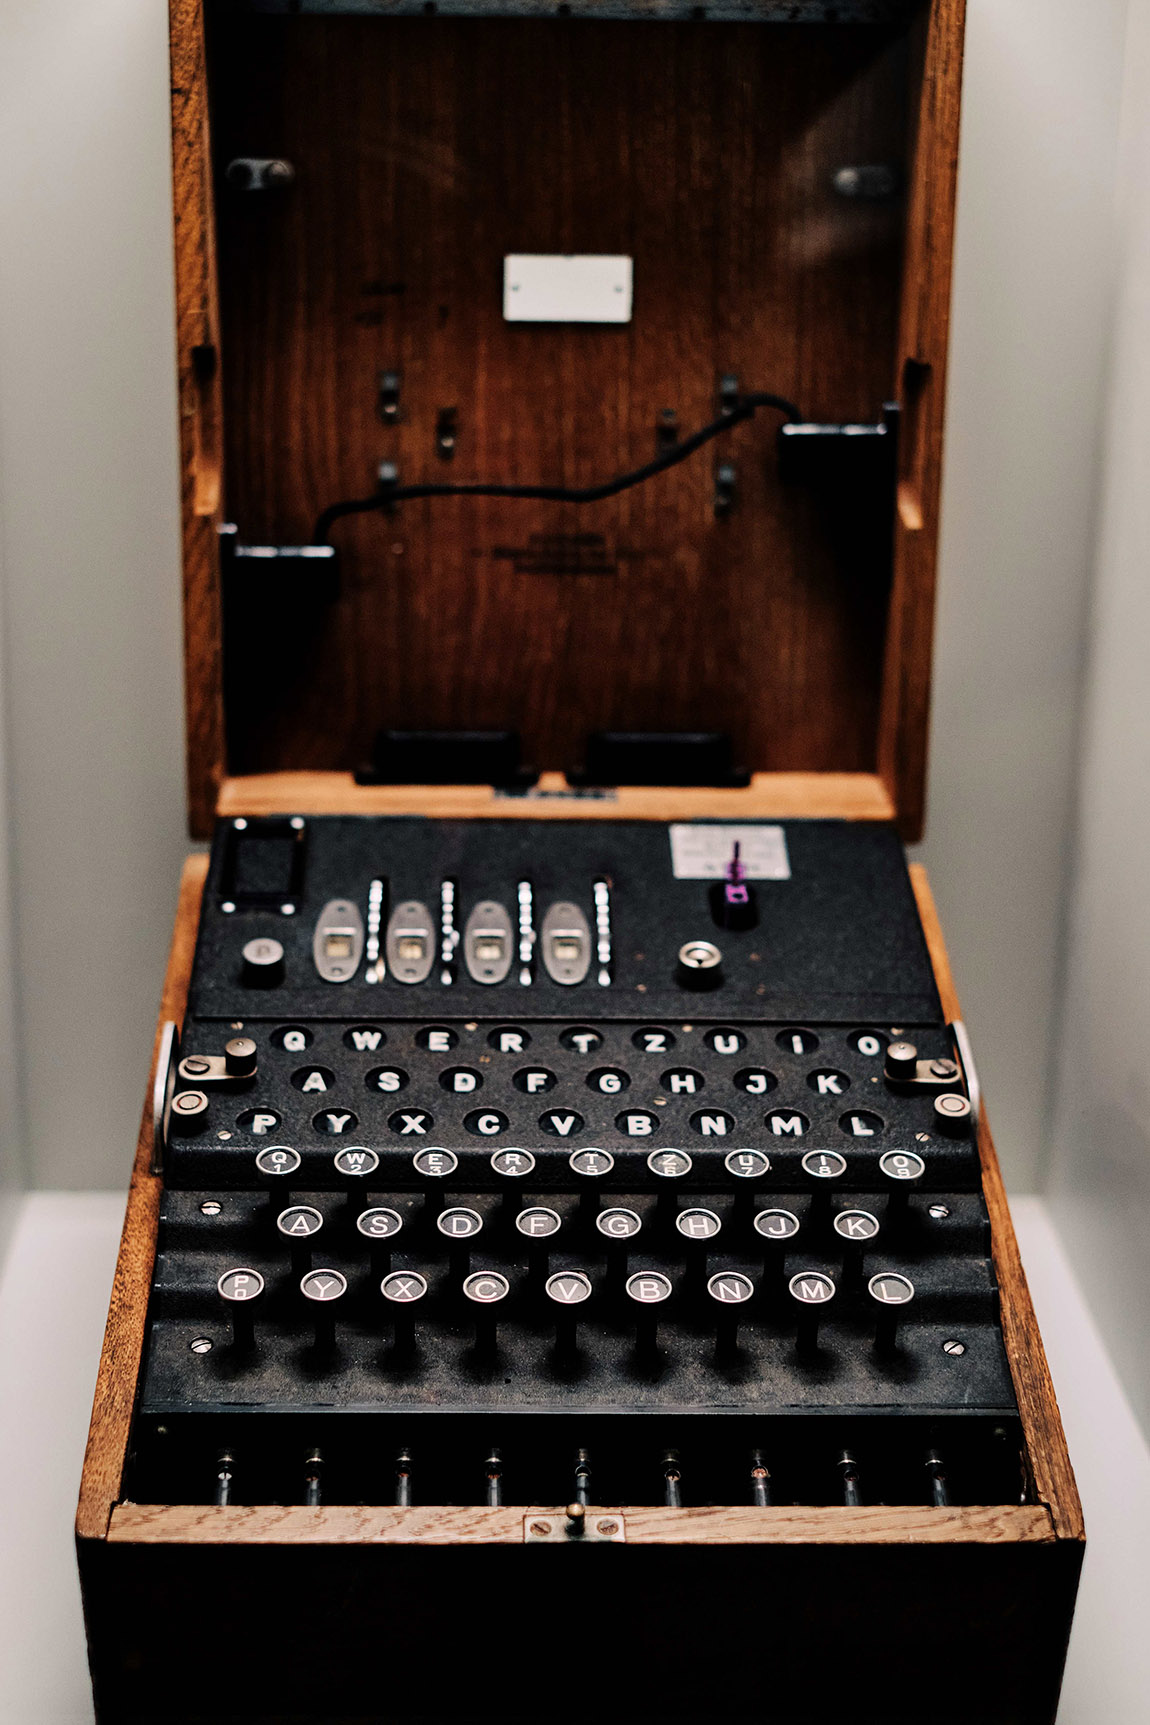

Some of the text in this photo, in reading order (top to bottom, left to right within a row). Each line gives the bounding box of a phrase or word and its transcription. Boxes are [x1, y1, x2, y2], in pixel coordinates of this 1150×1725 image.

[283, 1031, 880, 1055] Q W E R T Z U I O
[302, 1072, 841, 1094] A S D F G H J K
[253, 1114, 874, 1135] P Y X C V B N M L
[272, 1153, 908, 1167] Q W E R T Z U I O
[274, 1165, 908, 1176] 1 2 3 4 5 6 7 8 9
[290, 1216, 867, 1235] A S D F G H J K
[234, 1275, 901, 1300] P Y X C V B N M L
[234, 1289, 247, 1297] 0
